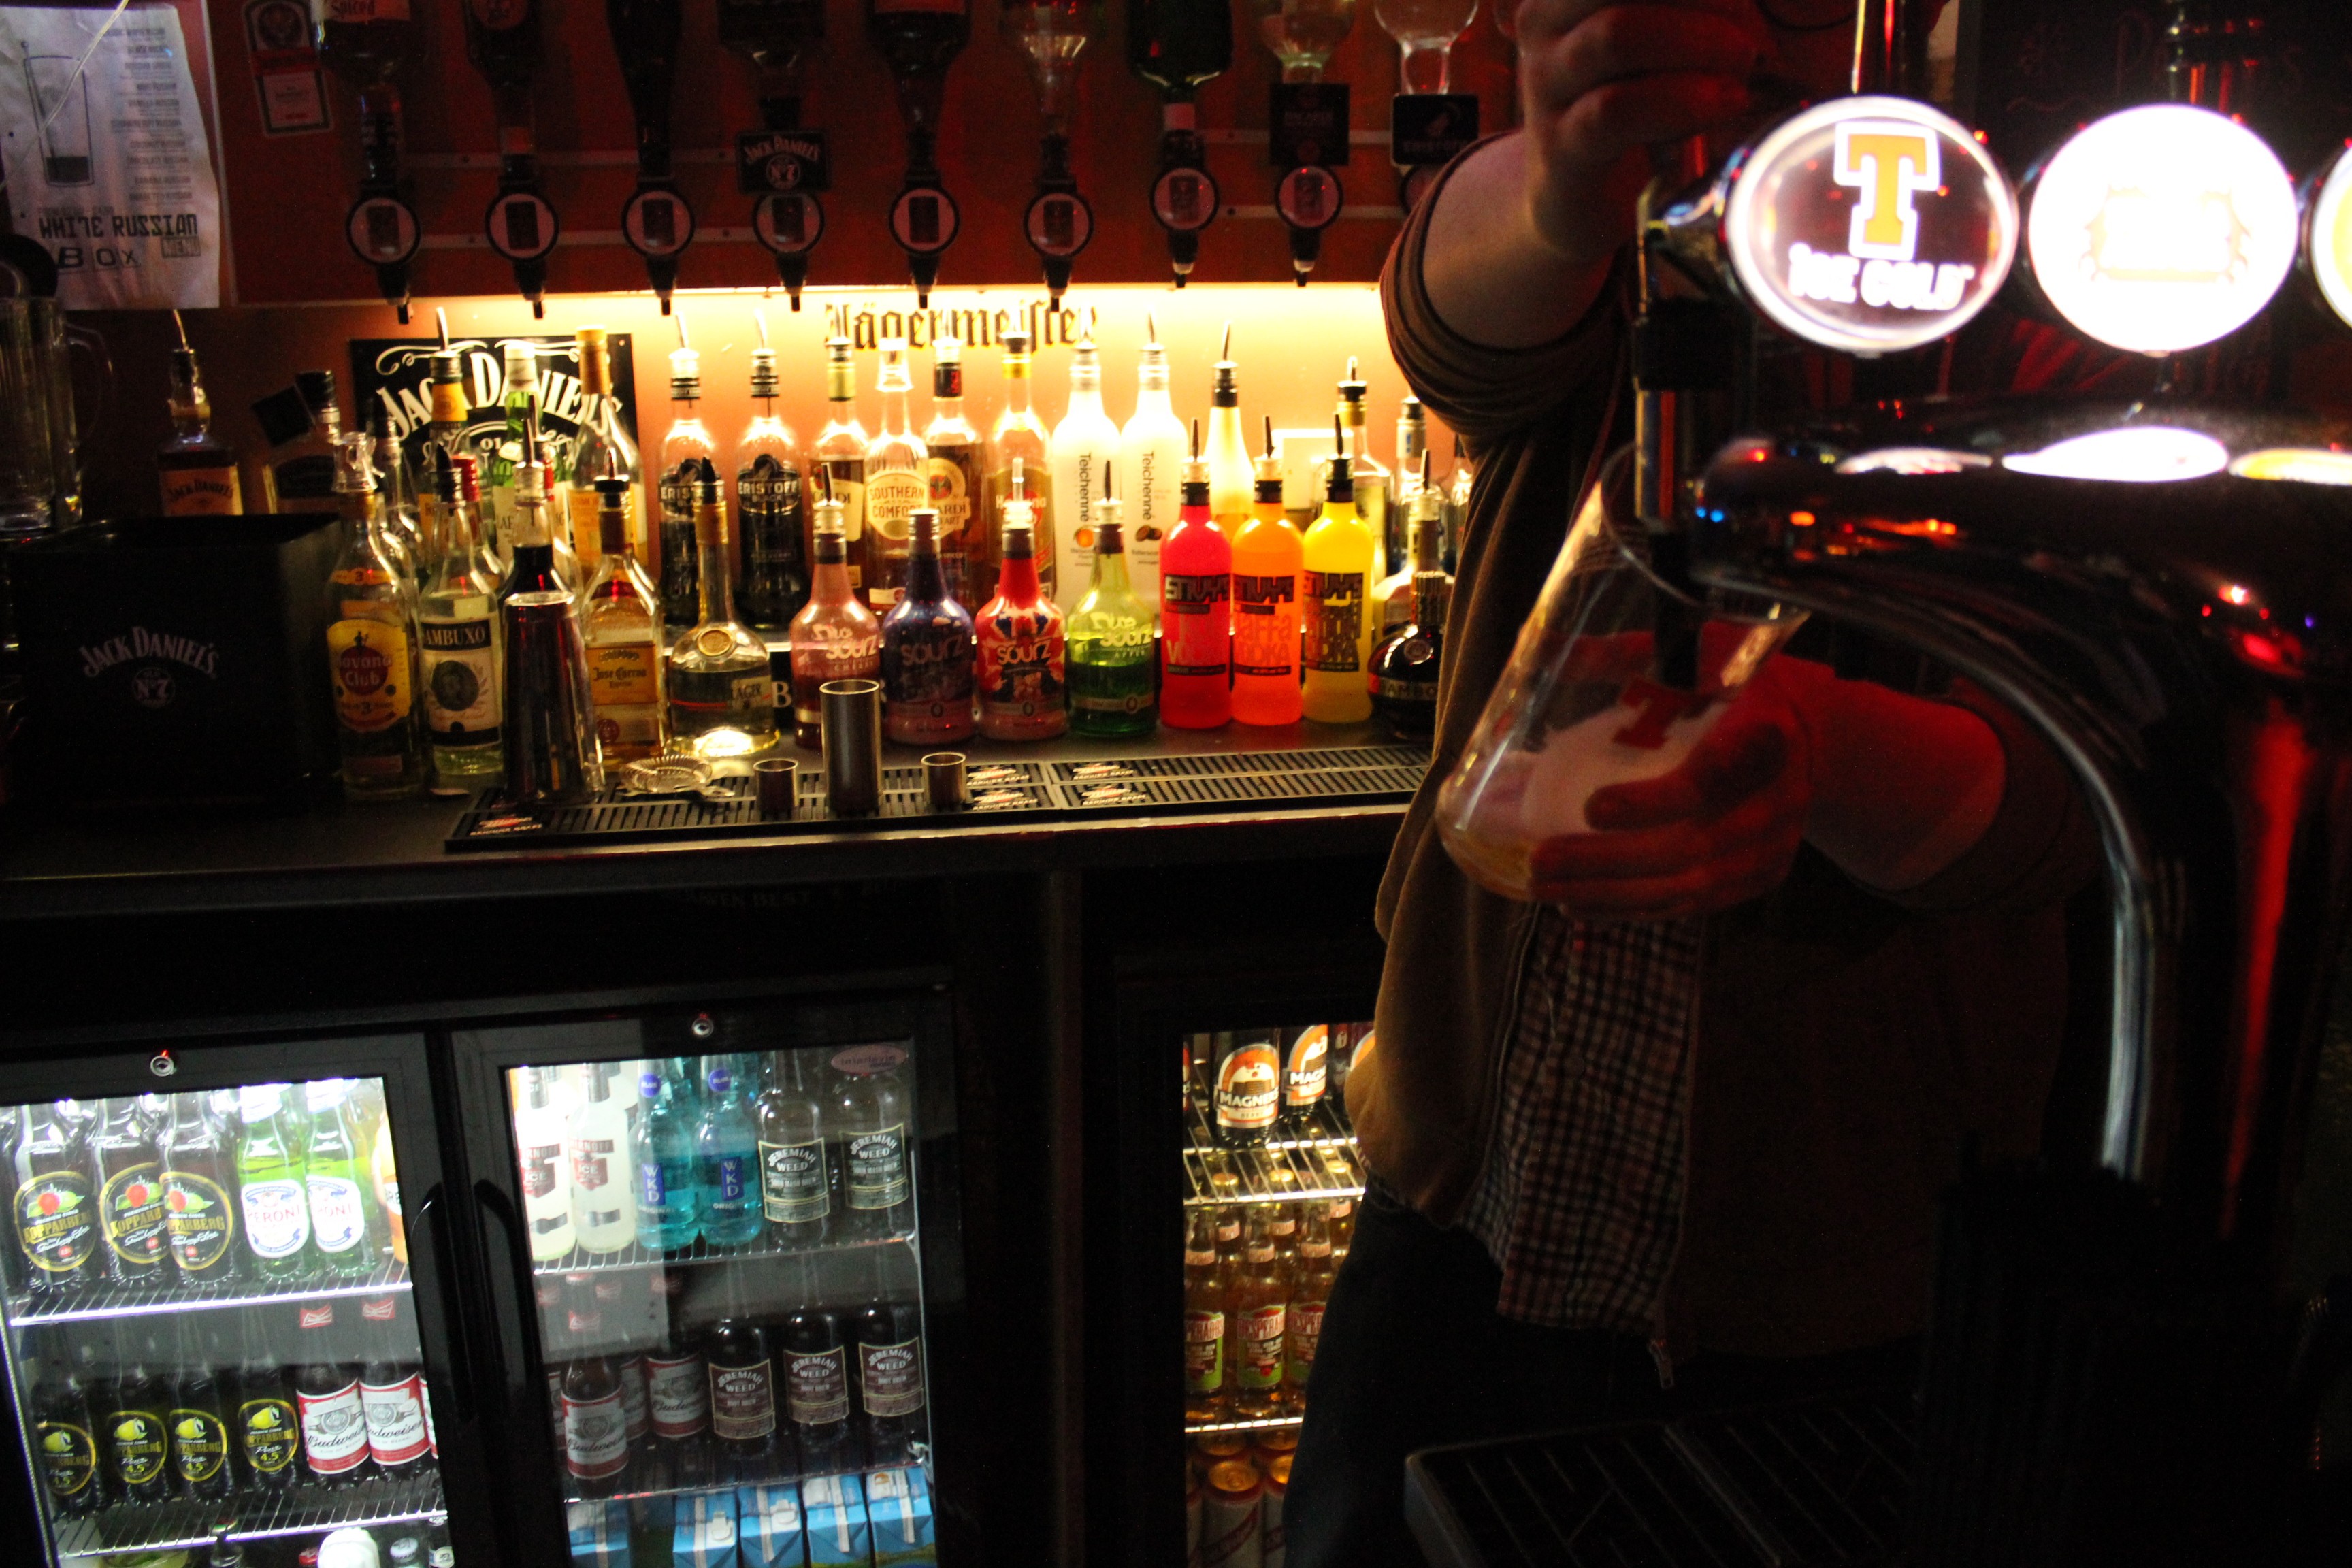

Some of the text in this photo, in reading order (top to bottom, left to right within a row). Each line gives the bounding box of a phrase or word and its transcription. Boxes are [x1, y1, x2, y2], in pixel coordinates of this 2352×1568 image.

[39, 213, 198, 238] WHITE RUSSIAN
[738, 480, 798, 495] ERISTOFF
[869, 485, 925, 501] SOUTHERN
[78, 625, 220, 680] JACK DANIEL'S
[345, 668, 381, 687] Club
[1290, 1067, 1326, 1086] MAGN
[1220, 1087, 1279, 1107] MAGNERS
[849, 1134, 898, 1155] JEREMIAH
[858, 1147, 891, 1159] WEED
[767, 1147, 817, 1167] JEREMIAH
[776, 1160, 808, 1172] WEED
[644, 1164, 660, 1202] WKD
[723, 1158, 740, 1197] WKD
[110, 1206, 163, 1238] KOPPARB
[247, 1204, 301, 1223] PERONI
[23, 1211, 94, 1243] KOPPARBER
[791, 1356, 838, 1374] JEREMIAH
[868, 1348, 914, 1367] JEREMIAH
[877, 1360, 906, 1371] WEED
[717, 1370, 764, 1388] JEREMIAH
[799, 1368, 830, 1378] WEED
[725, 1382, 756, 1392] WEED
[307, 1422, 364, 1448] Budweis
[367, 1416, 425, 1438] udweiser
